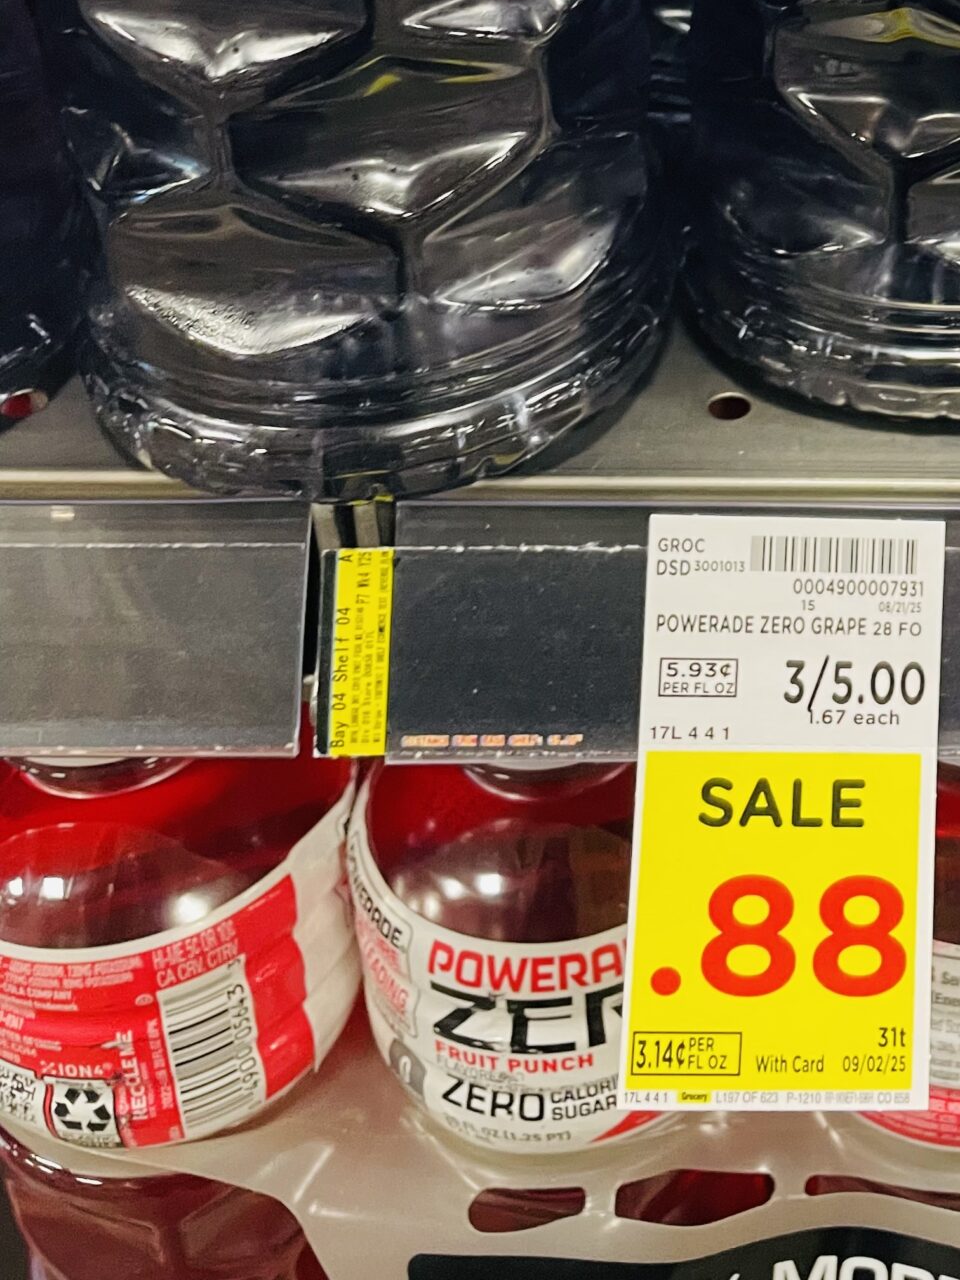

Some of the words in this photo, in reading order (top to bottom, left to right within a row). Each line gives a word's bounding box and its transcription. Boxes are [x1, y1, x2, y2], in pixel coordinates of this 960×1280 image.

[658, 537, 706, 553] GROC
[339, 554, 353, 563] A
[656, 559, 691, 576] DSD
[694, 560, 745, 573] 3001013
[792, 578, 925, 597] 0004900007931
[801, 599, 816, 611] 15
[336, 607, 351, 625] 04
[656, 613, 754, 634] POWERADE
[760, 615, 805, 635] ZERO
[811, 616, 868, 637] GRAPE
[872, 621, 893, 636] 28
[898, 621, 923, 637] FO
[333, 637, 349, 682] Shelf
[665, 661, 732, 679] 5.93¢
[663, 681, 690, 694] PER
[694, 682, 709, 694] FL
[714, 682, 735, 695] OZ
[783, 654, 926, 713] 3/5.00
[332, 693, 347, 711] 04
[808, 709, 847, 726] 1.67
[853, 709, 901, 726] each
[330, 720, 347, 748] Bay
[650, 726, 683, 741] 17L
[697, 776, 867, 829] SALE
[650, 873, 908, 999] .88
[428, 938, 626, 993] POWERA
[688, 1037, 715, 1053] PER
[878, 1026, 908, 1049] 31t
[435, 1039, 500, 1070] FRUIT
[507, 1052, 594, 1074] PUNCH
[687, 1055, 703, 1070] FL
[708, 1055, 728, 1070] OZ
[756, 1054, 788, 1073] With
[792, 1055, 825, 1073] Card
[842, 1055, 907, 1075] 09/02/25
[442, 1073, 545, 1121] ZERO
[551, 1094, 617, 1121] SUGAR
